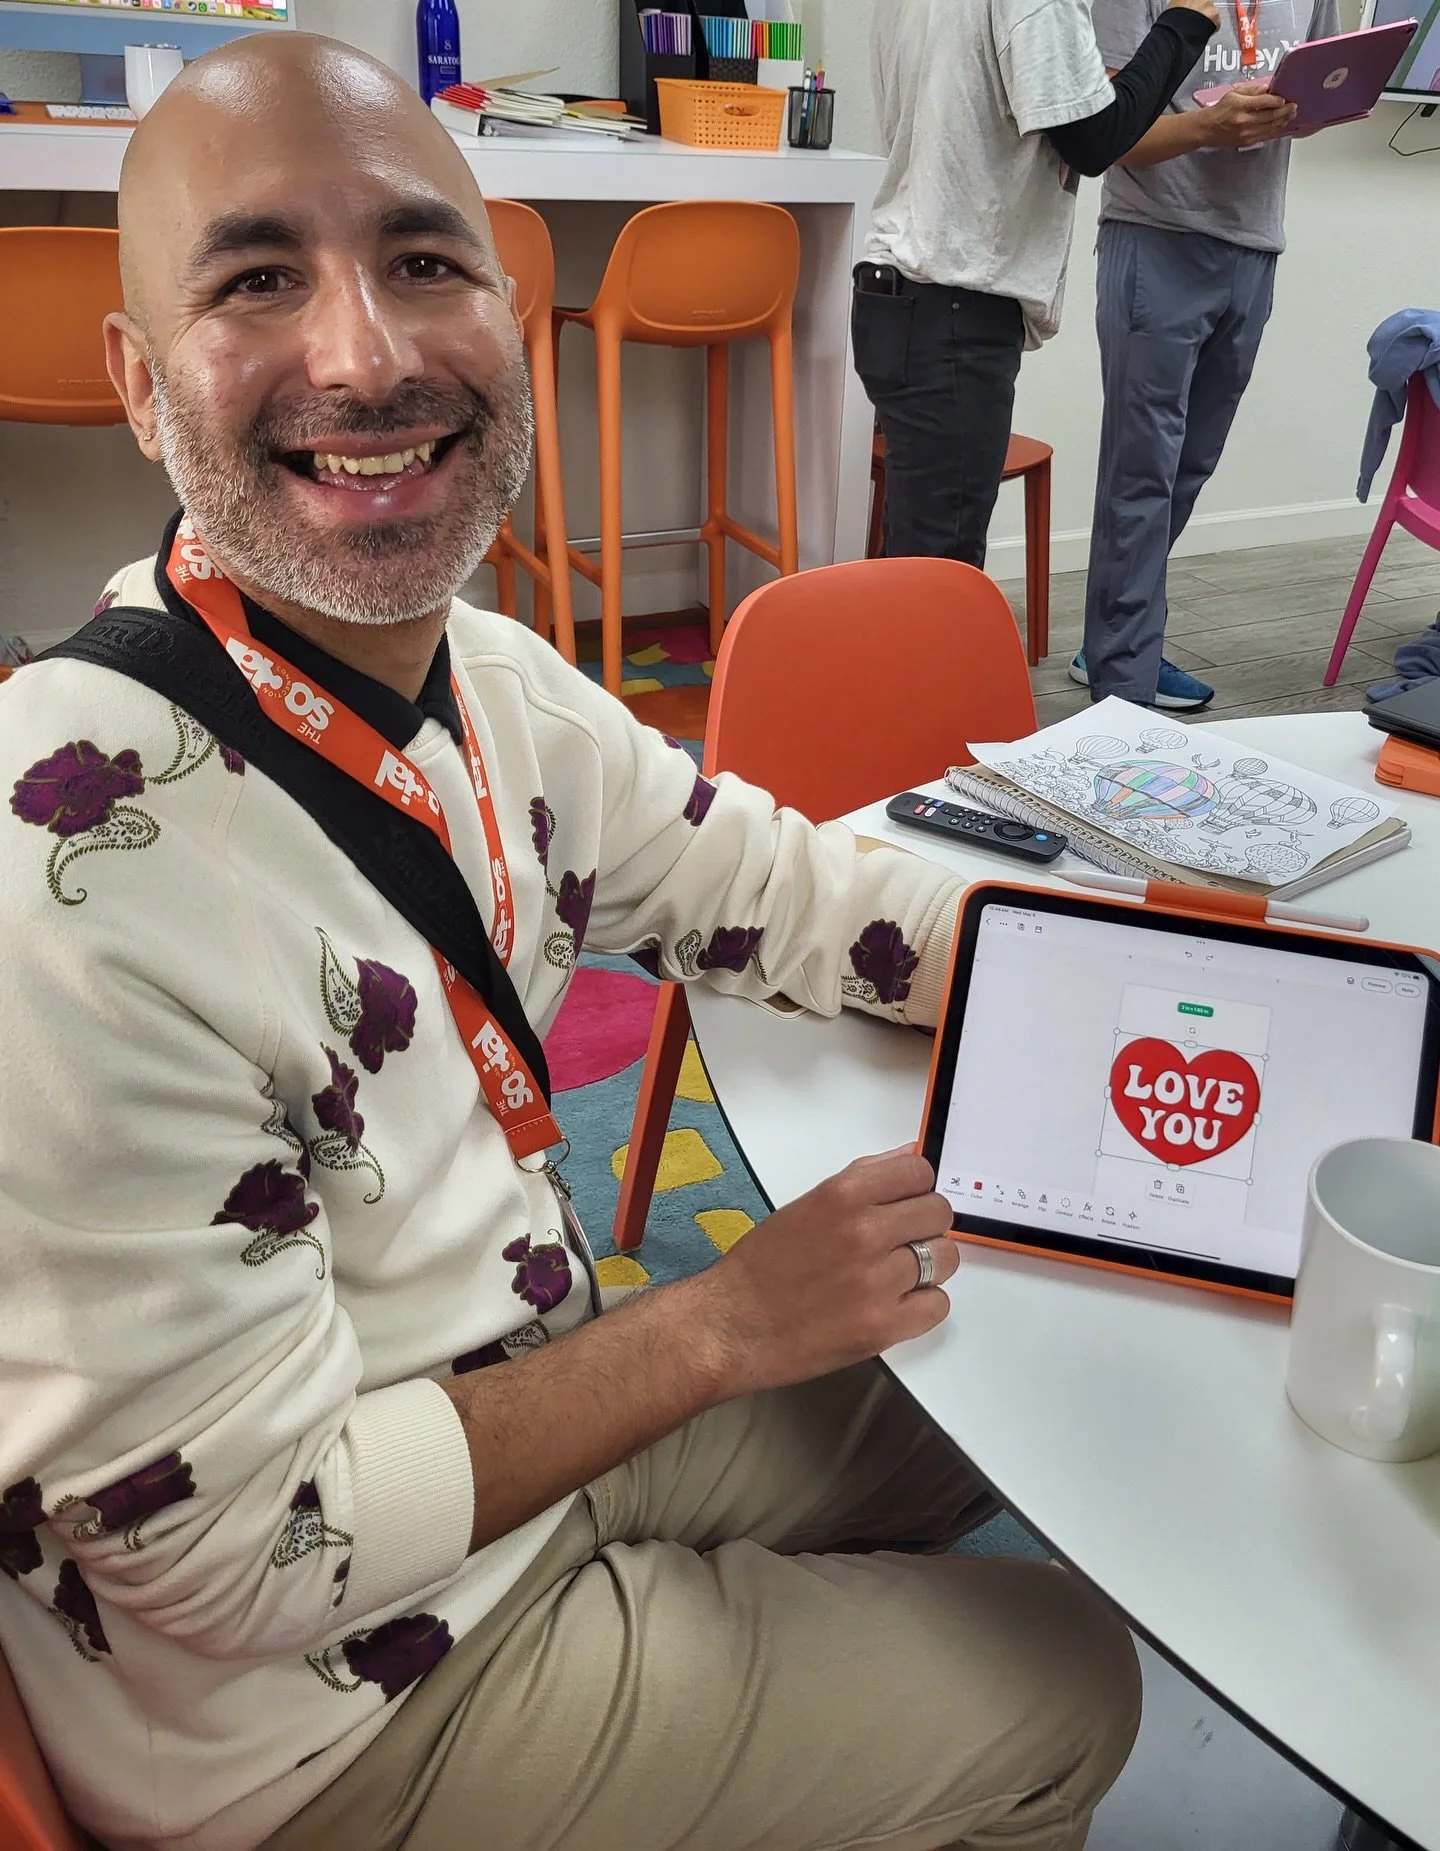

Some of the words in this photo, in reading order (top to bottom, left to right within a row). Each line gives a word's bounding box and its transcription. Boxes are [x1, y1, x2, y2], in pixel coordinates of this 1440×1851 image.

[1203, 44, 1281, 73] Huey
[297, 721, 322, 745] THE
[1123, 1064, 1244, 1117] LOVE
[495, 1099, 510, 1117] THE
[1138, 1106, 1223, 1151] YOU
